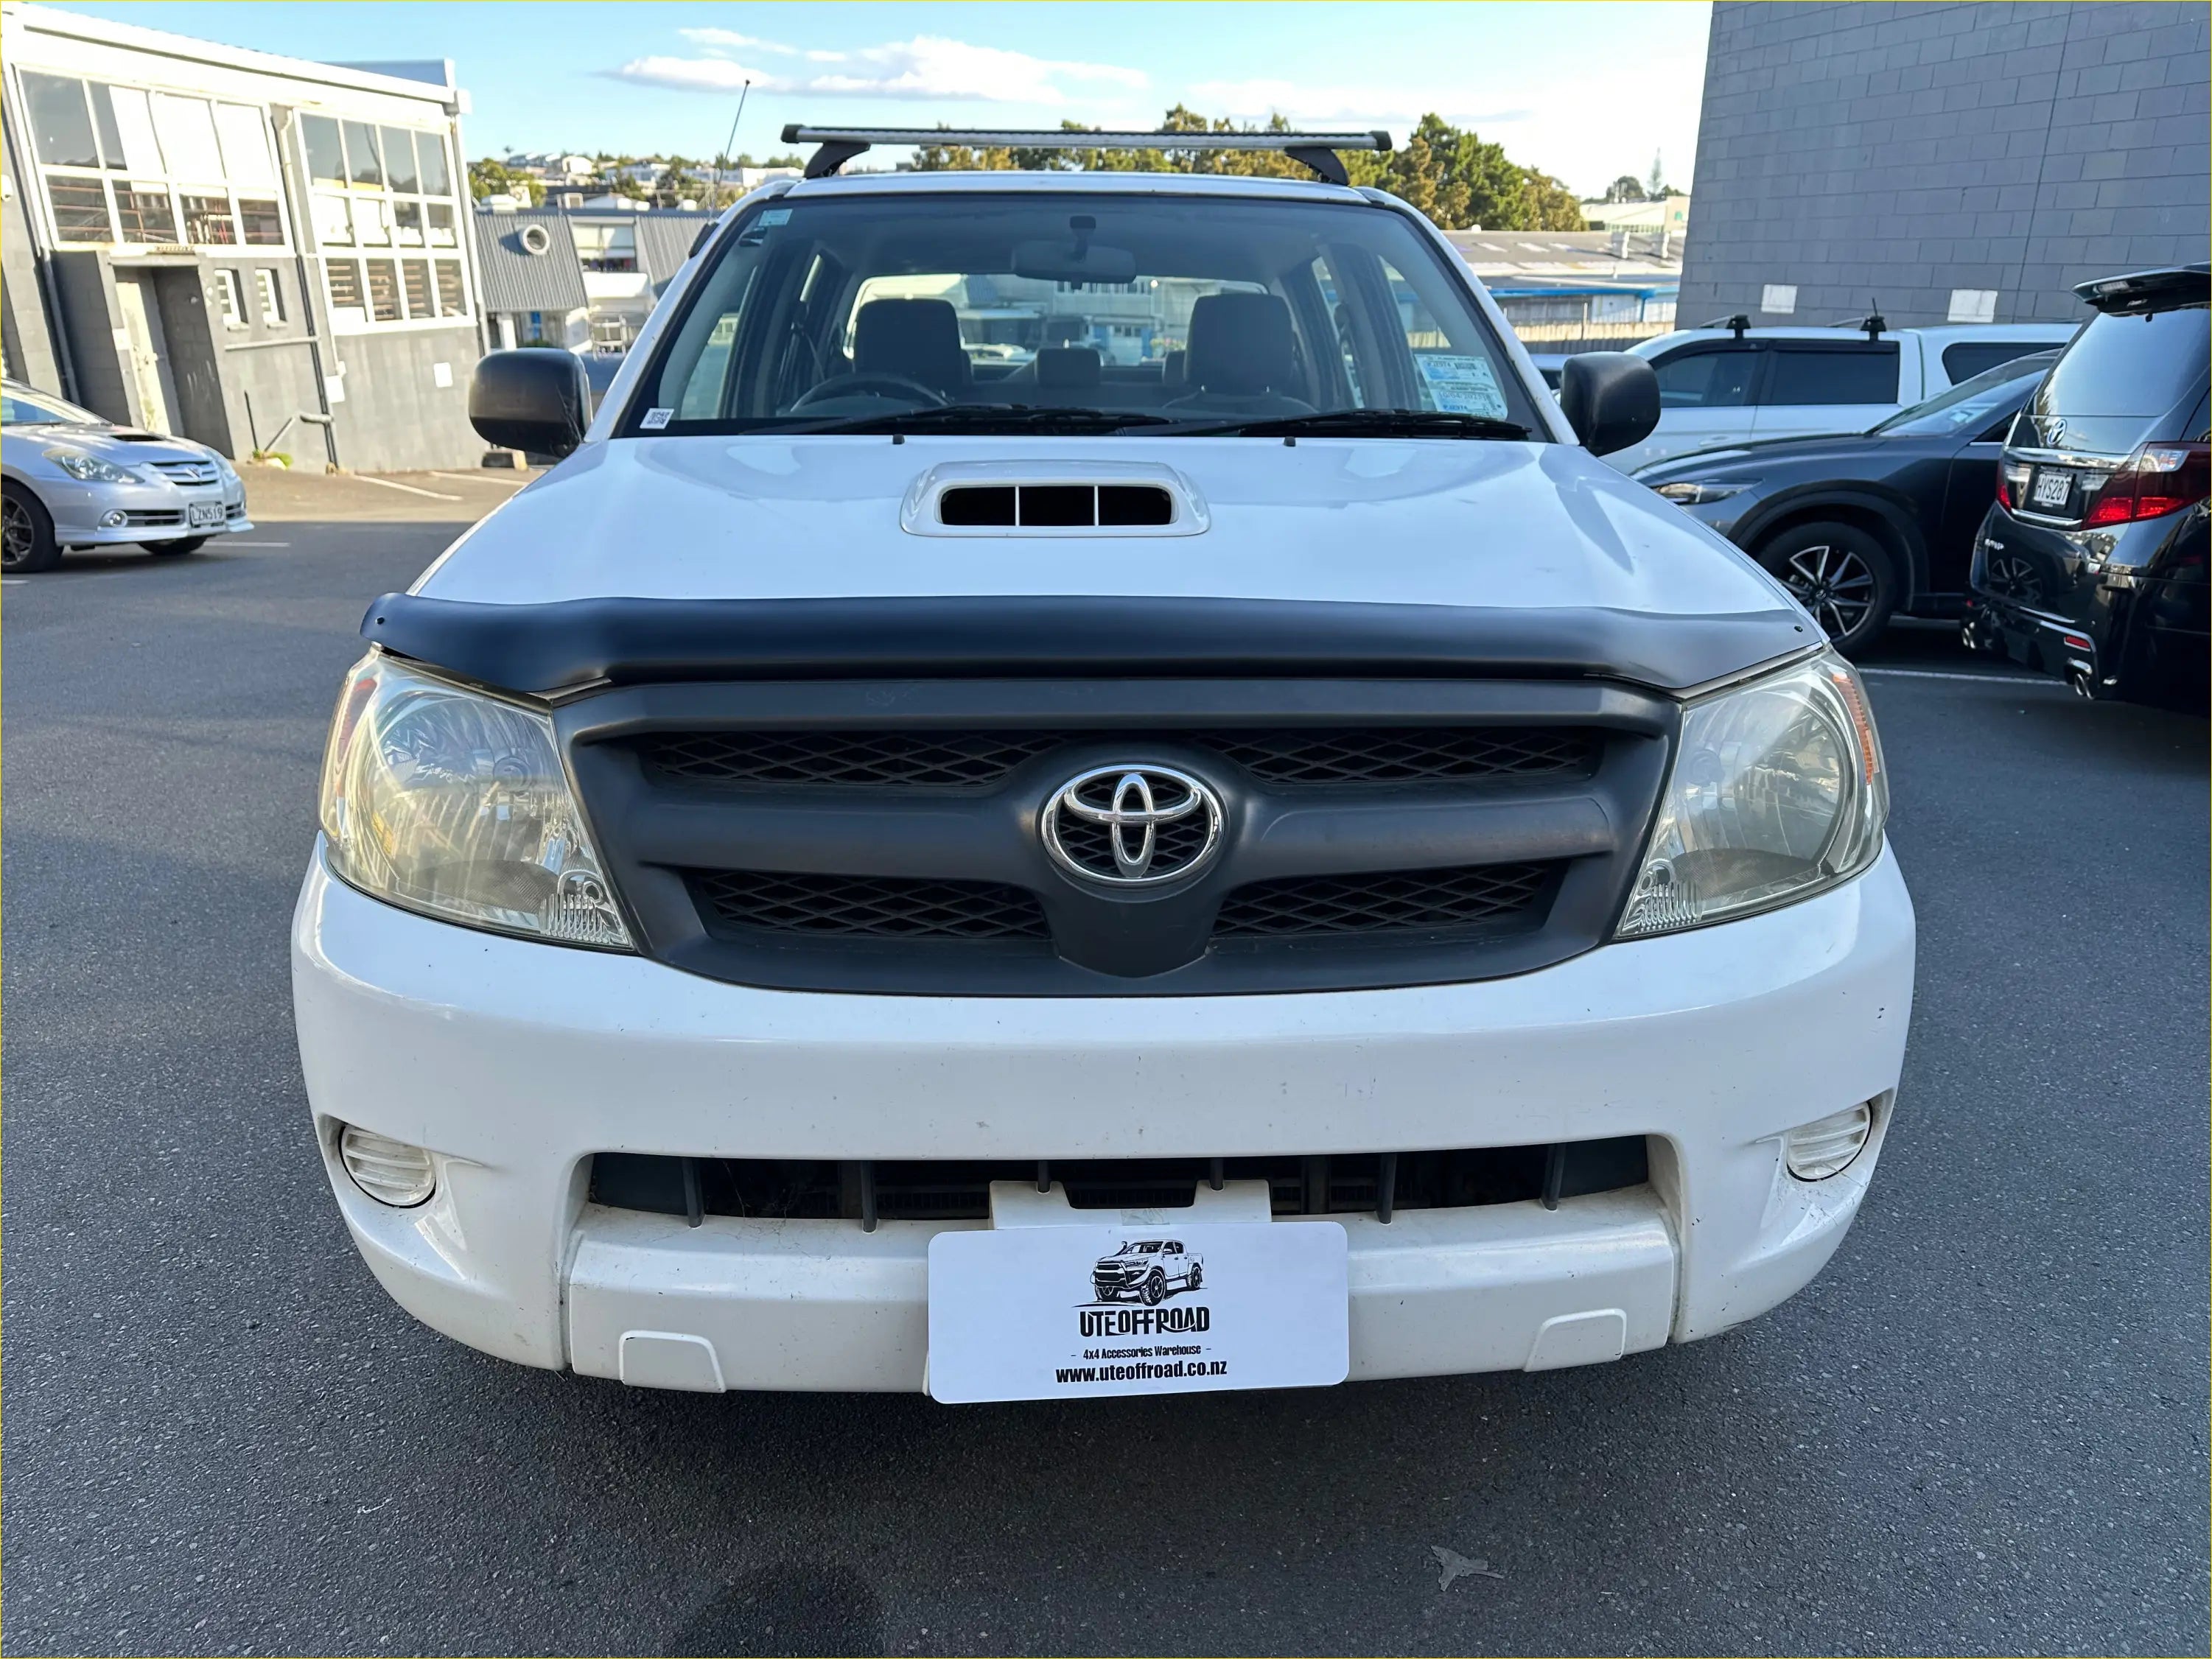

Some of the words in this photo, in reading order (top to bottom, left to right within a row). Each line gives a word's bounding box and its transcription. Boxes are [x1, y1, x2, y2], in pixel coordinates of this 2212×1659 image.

[2037, 478, 2070, 501] HYS287
[192, 506, 223, 521] LZN519
[1083, 1349, 1100, 1360] 4x4
[1102, 1347, 1153, 1359] Accessories
[1154, 1345, 1202, 1356] Warehouse
[1056, 1361, 1228, 1383] www.uteoffroad.co.nz
